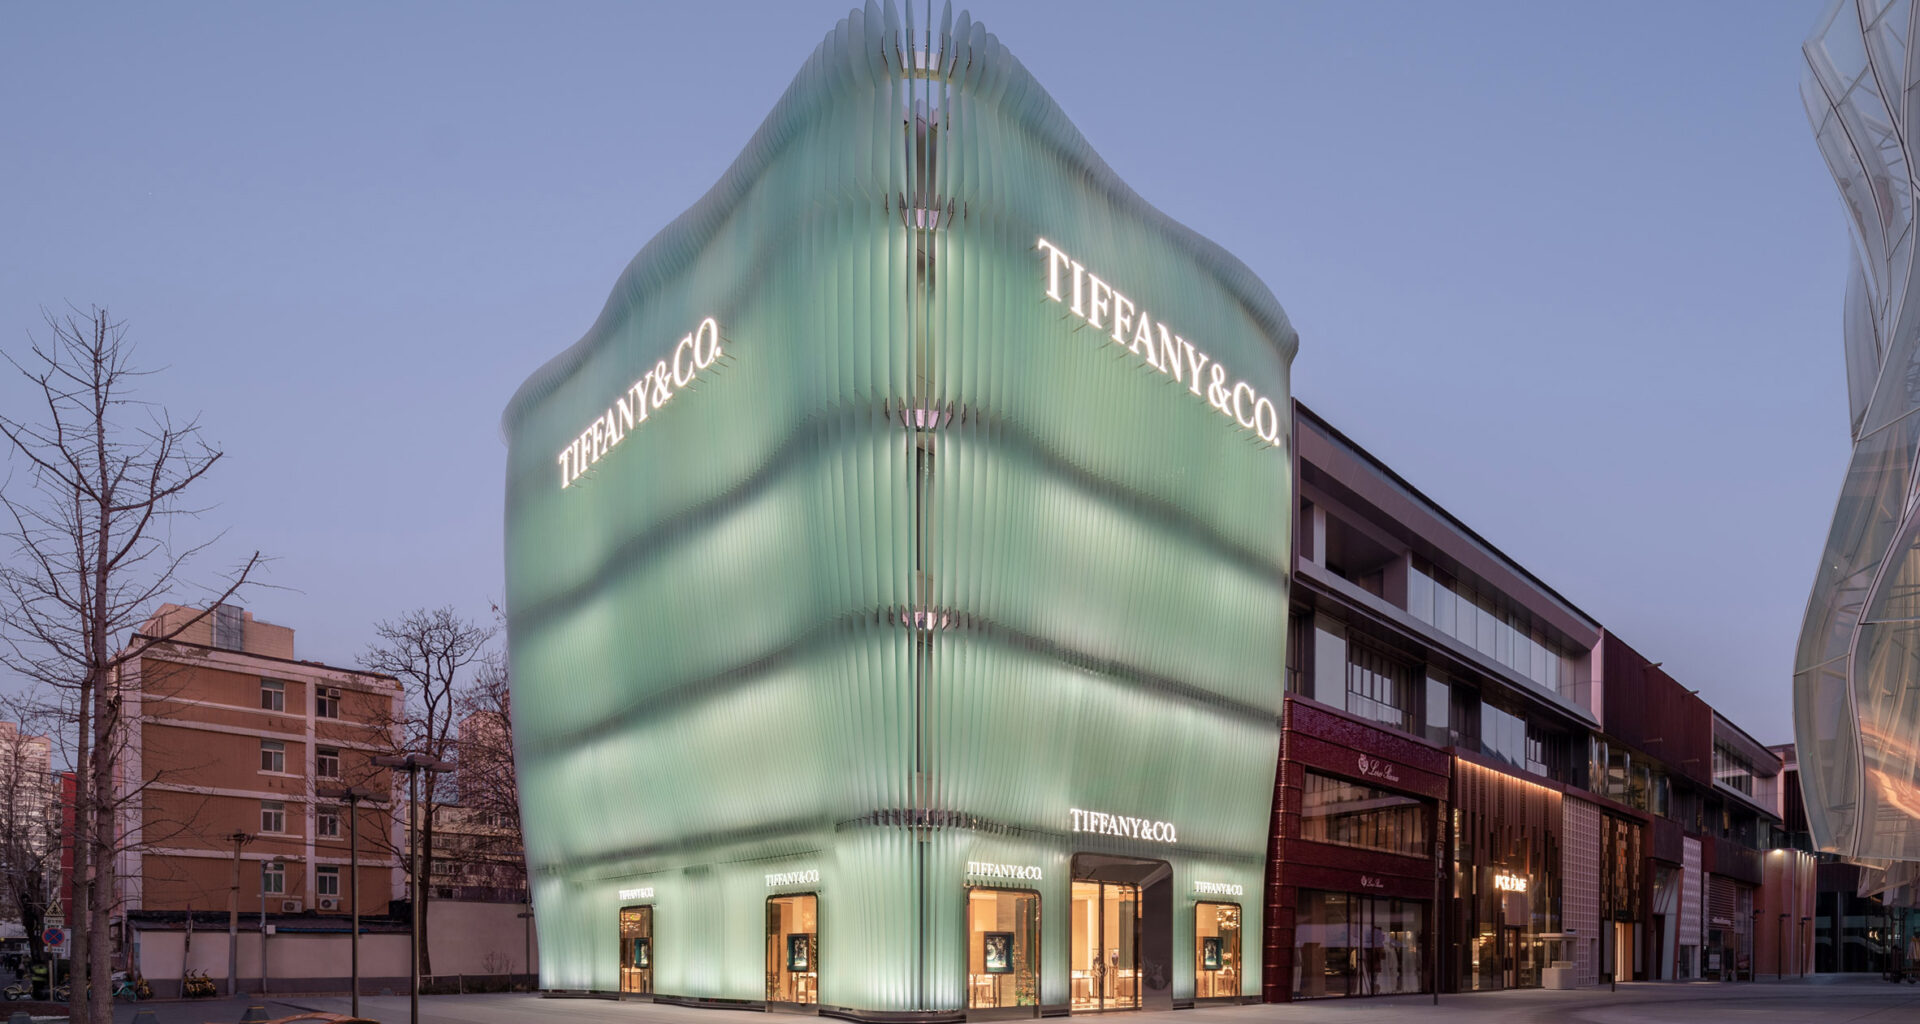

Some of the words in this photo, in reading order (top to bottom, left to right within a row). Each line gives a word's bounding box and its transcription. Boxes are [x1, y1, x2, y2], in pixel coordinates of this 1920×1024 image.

[1037, 237, 1281, 447] TIFFANY&CO.
[558, 317, 722, 489] TIFFANY&CO.
[967, 860, 1043, 881] TIFFANY&CO.
[1069, 807, 1177, 843] TIFFANY&CO.
